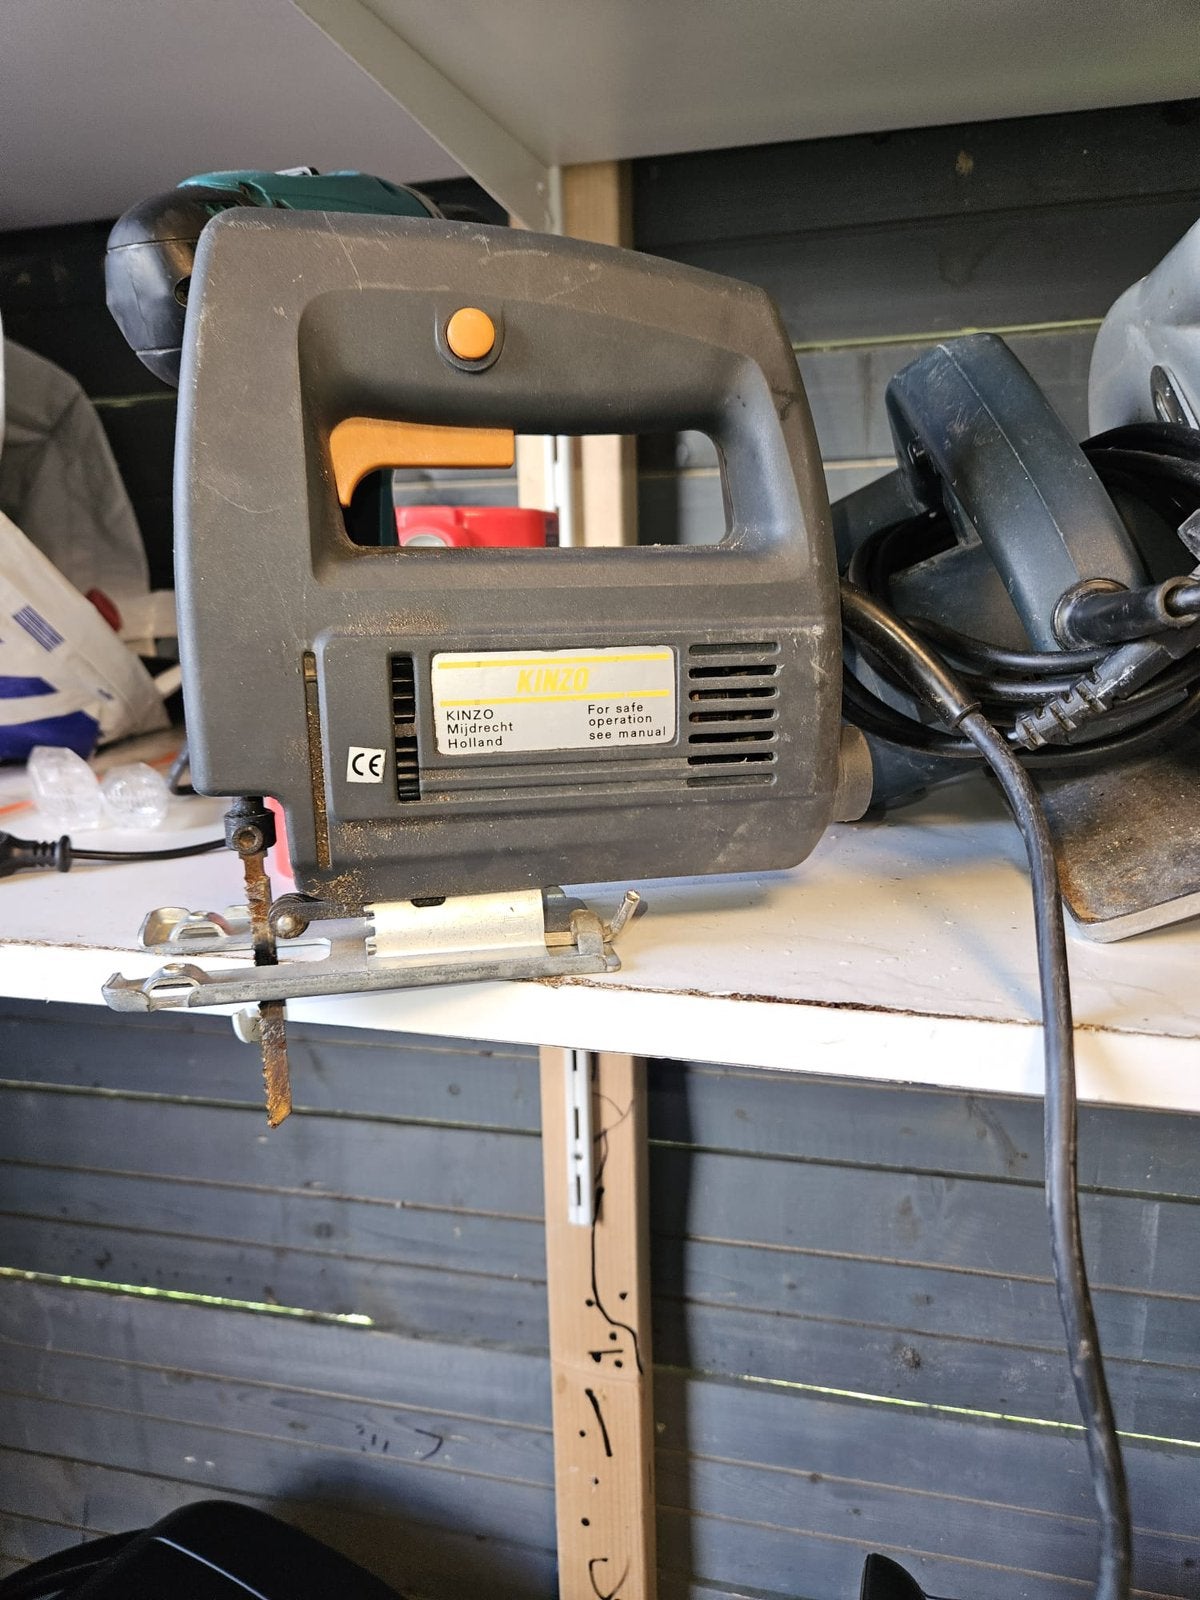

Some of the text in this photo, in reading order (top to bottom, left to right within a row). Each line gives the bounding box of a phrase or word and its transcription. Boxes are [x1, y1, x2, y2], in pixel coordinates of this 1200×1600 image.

[516, 667, 590, 693] KINZO
[446, 709, 494, 721] KINZO
[588, 703, 643, 715] For safe
[589, 714, 652, 728] operation
[447, 722, 513, 736] Mijdrecht
[589, 726, 666, 740] see manual
[448, 736, 503, 748] Holland
[352, 753, 382, 777] CE
